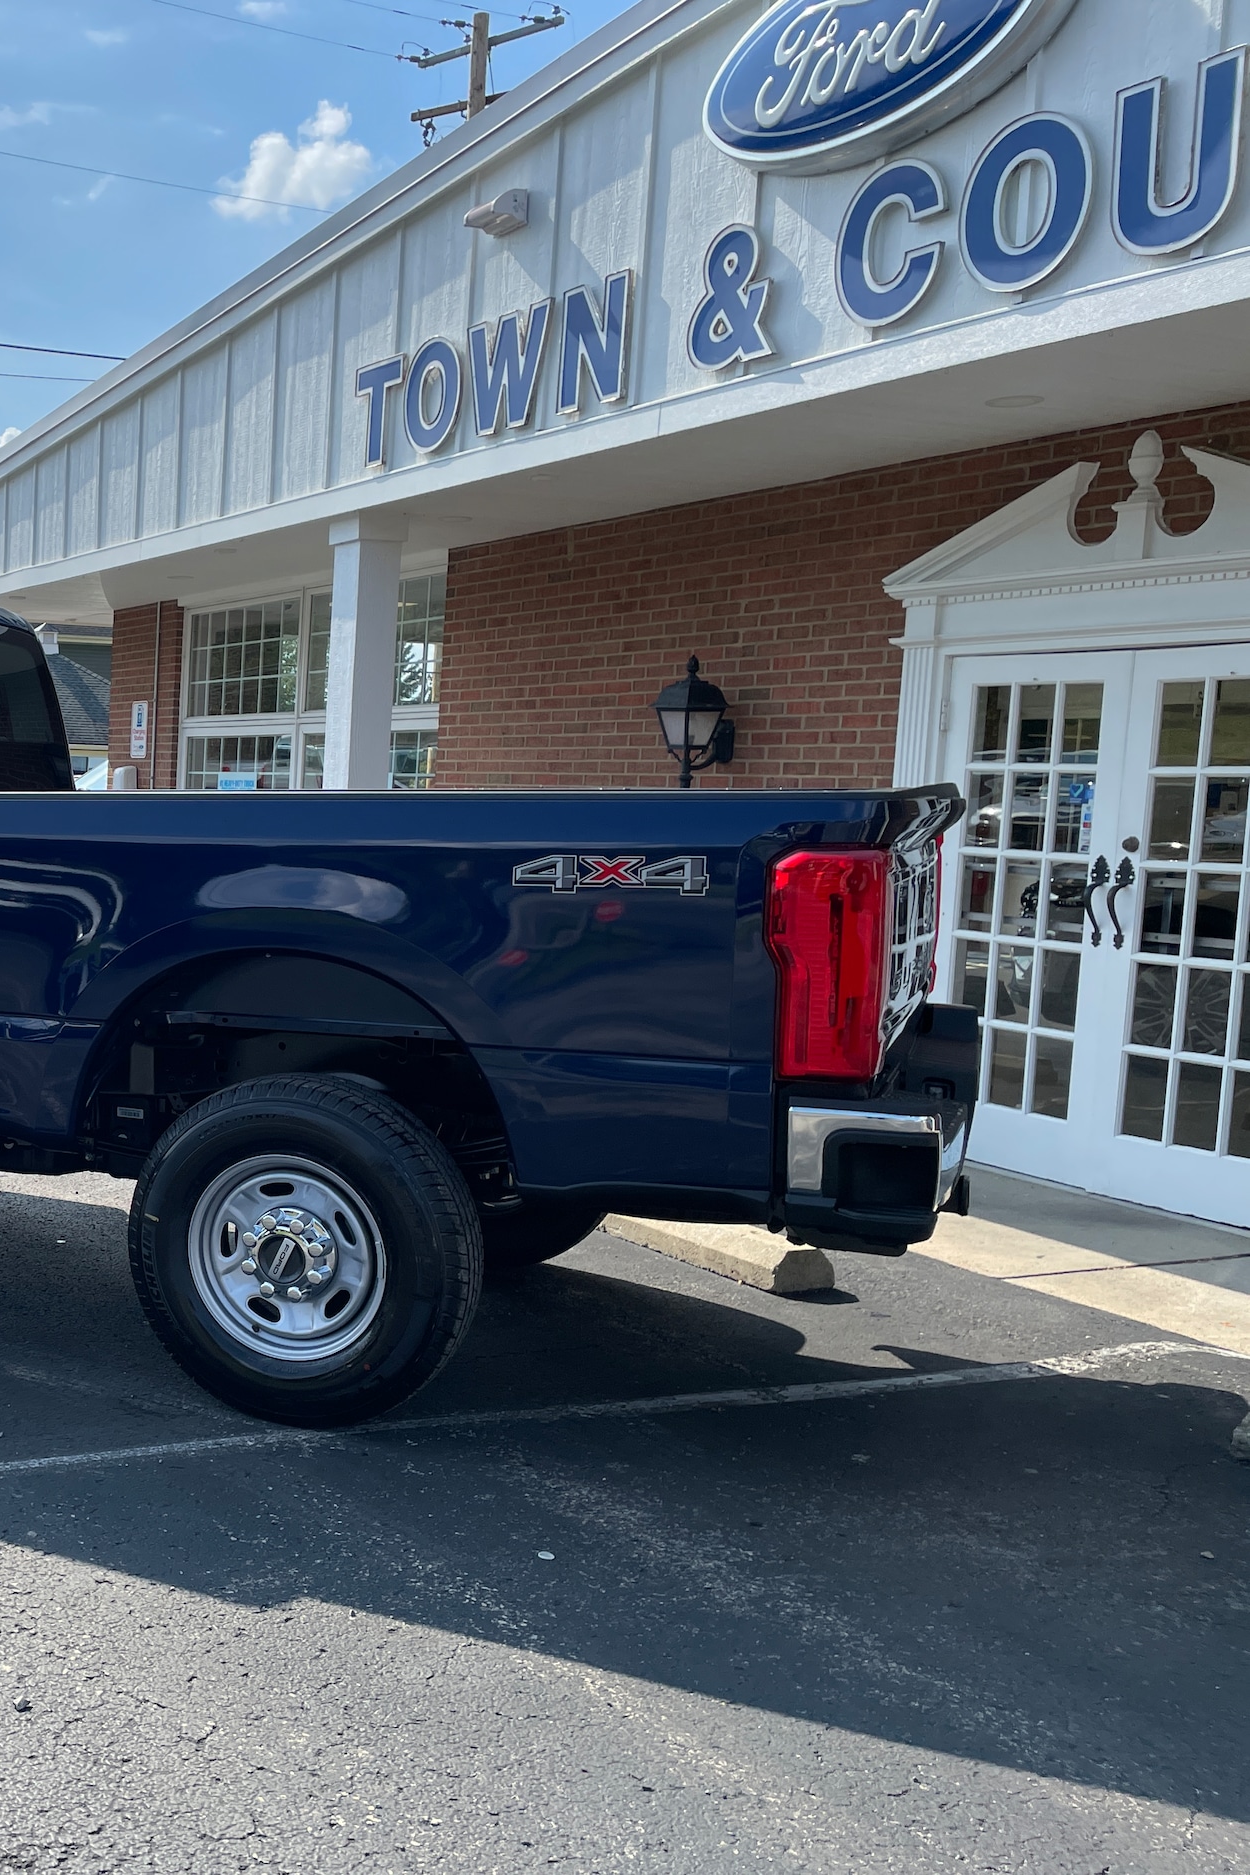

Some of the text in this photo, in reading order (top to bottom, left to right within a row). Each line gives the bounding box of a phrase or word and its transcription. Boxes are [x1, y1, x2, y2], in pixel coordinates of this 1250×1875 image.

[754, 0, 946, 129] Ford
[355, 43, 1249, 468] TOWN & COU
[273, 1244, 290, 1275] FORD
